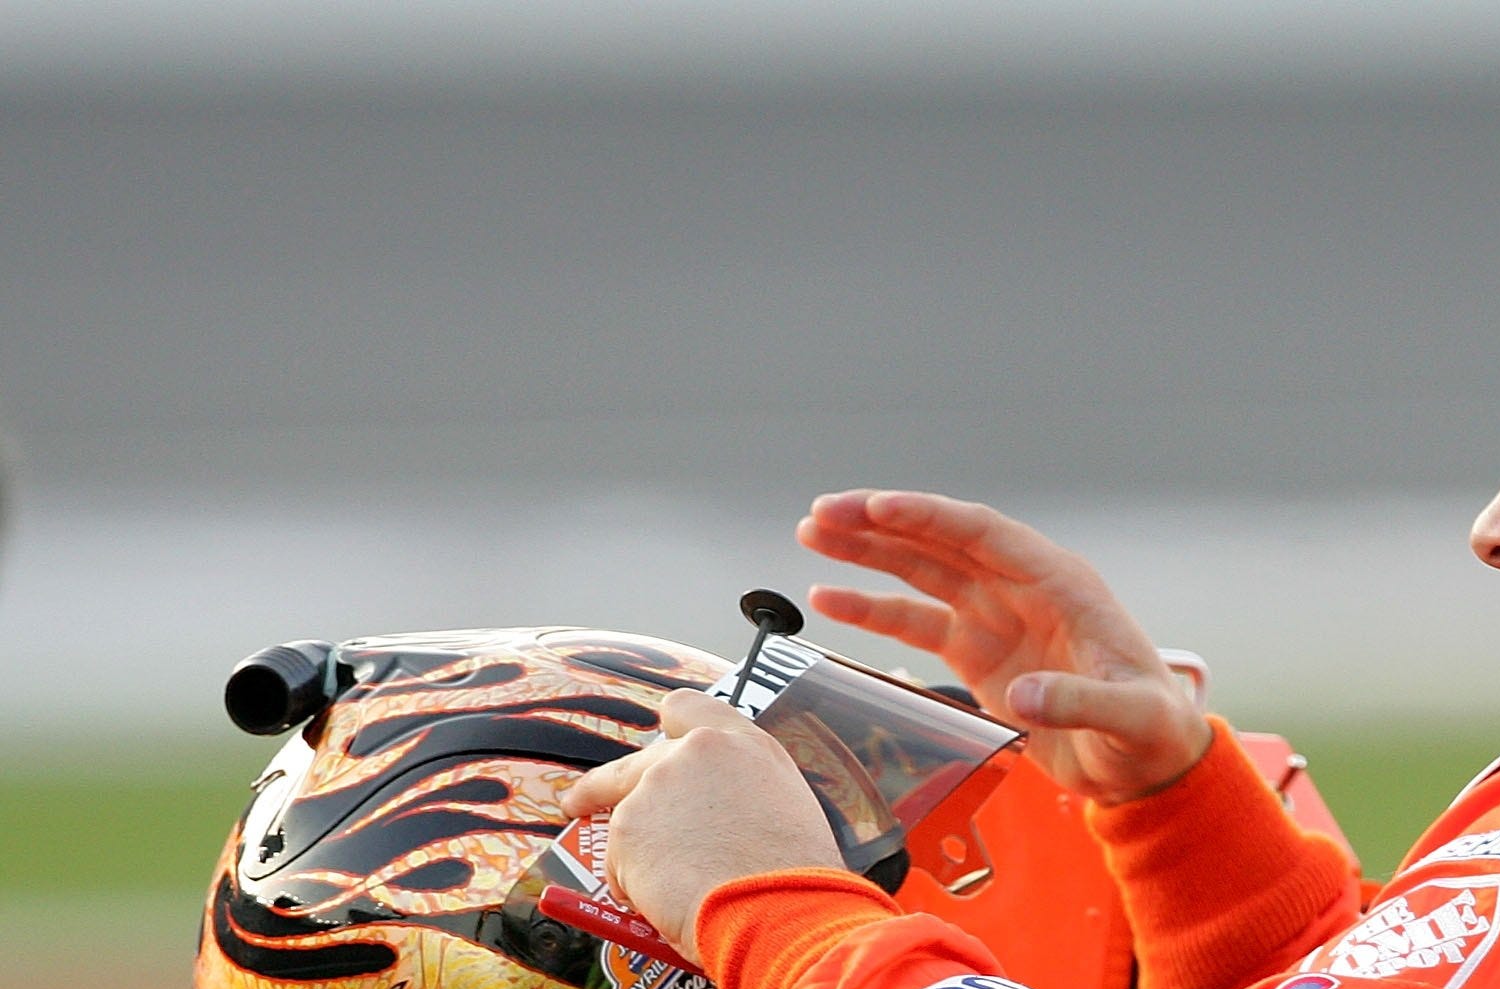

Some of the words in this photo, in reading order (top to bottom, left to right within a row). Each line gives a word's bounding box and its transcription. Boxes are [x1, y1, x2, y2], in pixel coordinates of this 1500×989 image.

[578, 827, 590, 856] THE
[1322, 888, 1490, 978] OME
[1329, 896, 1416, 957] THE
[1365, 937, 1467, 977] POT
